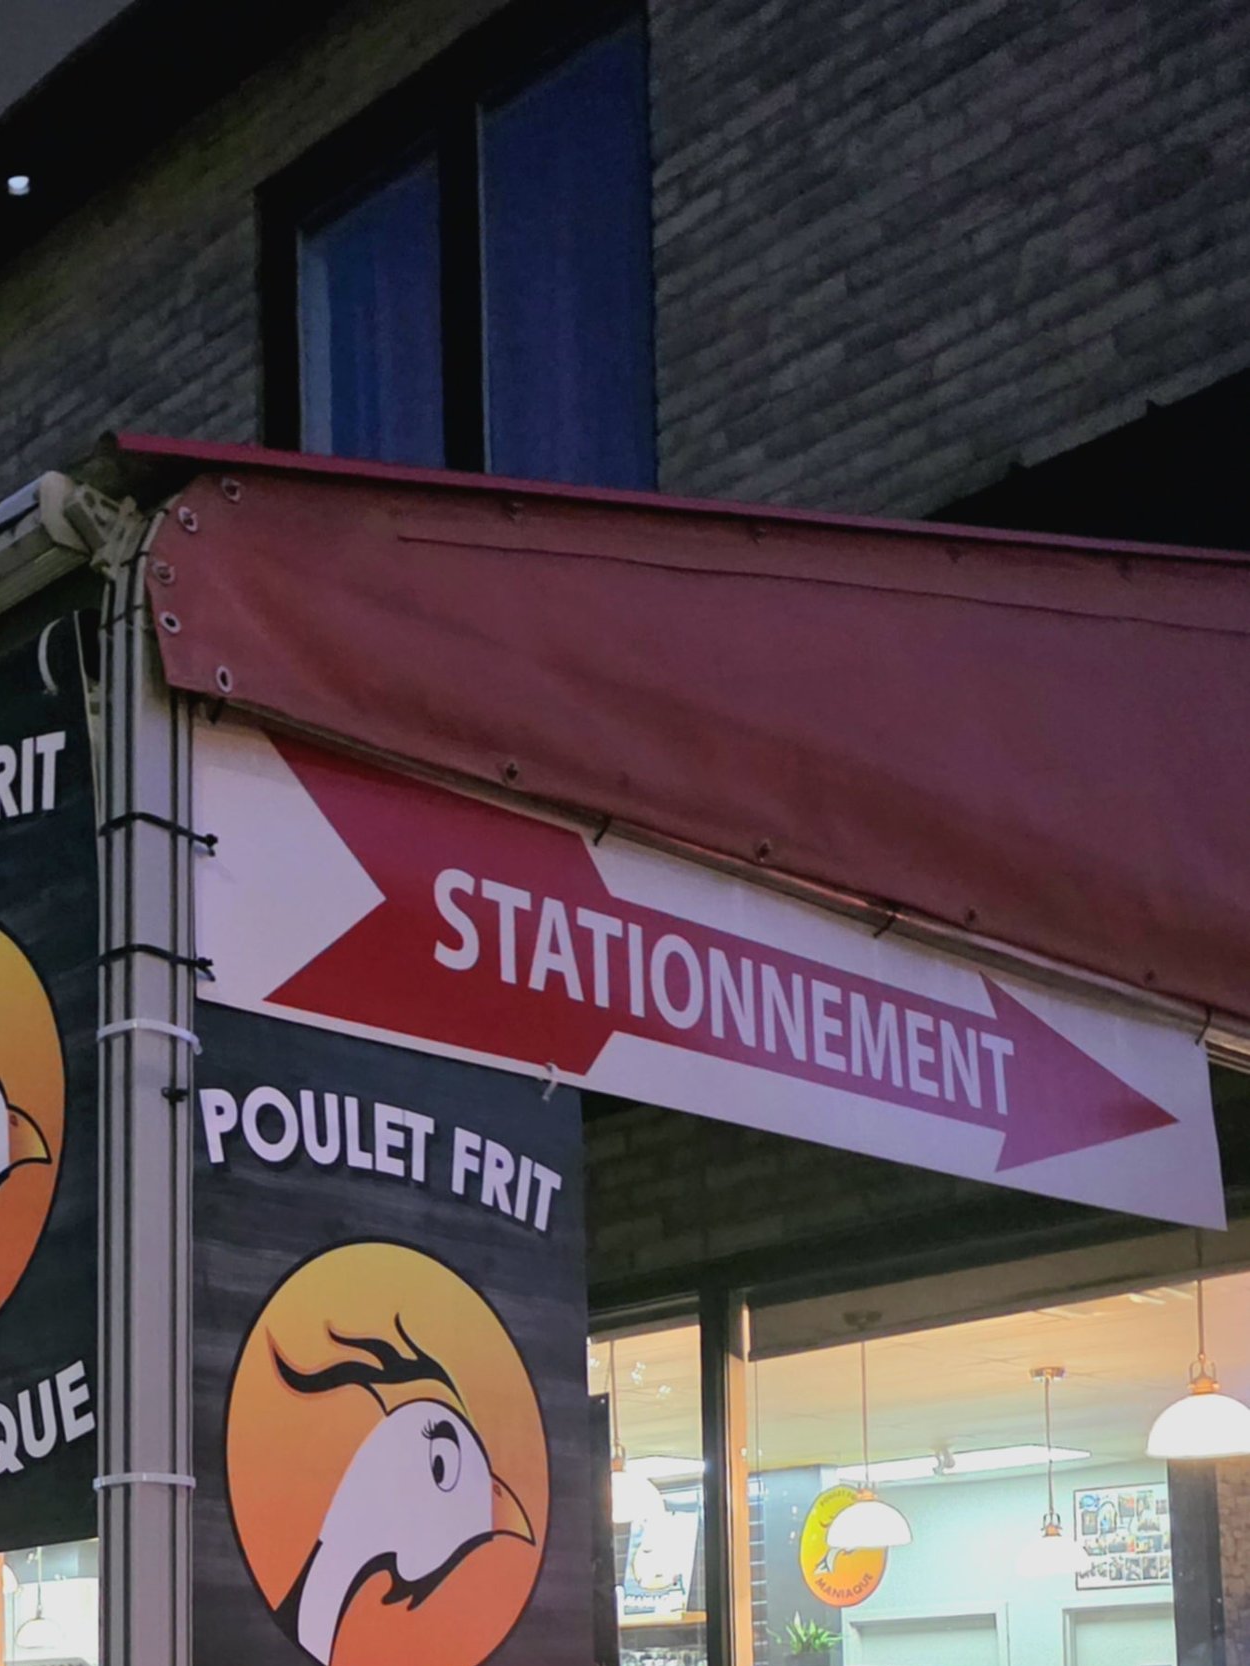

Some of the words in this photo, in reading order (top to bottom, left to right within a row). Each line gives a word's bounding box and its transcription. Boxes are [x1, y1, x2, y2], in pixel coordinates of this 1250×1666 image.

[433, 867, 1014, 1116] STATIONNEMENT
[199, 1085, 435, 1183] POULET
[450, 1126, 563, 1232] FRIT
[815, 1572, 873, 1598] MANIAQUE
